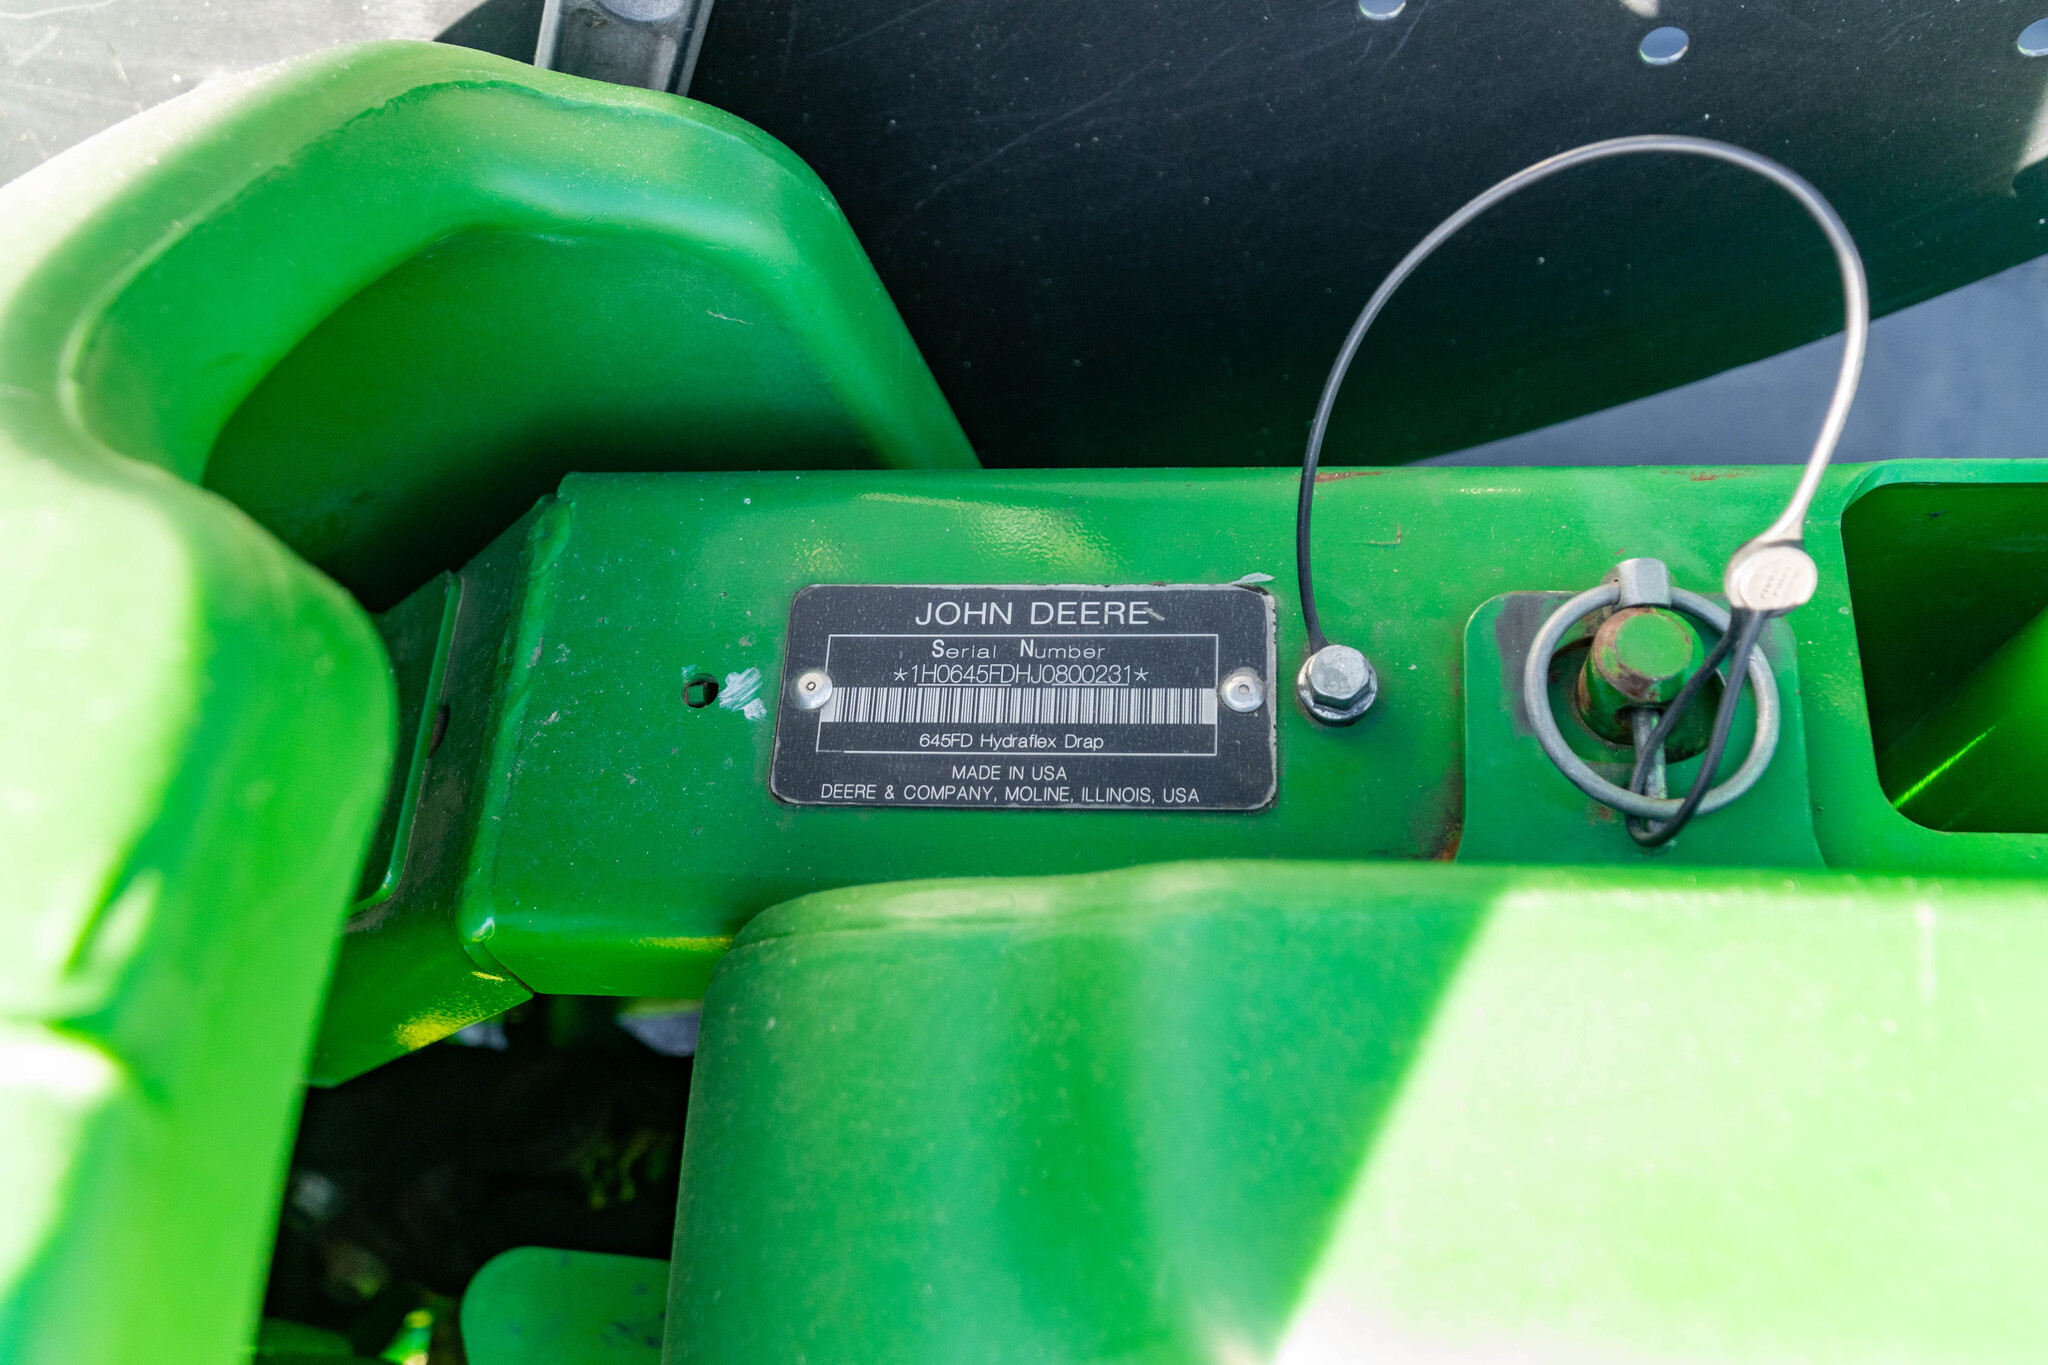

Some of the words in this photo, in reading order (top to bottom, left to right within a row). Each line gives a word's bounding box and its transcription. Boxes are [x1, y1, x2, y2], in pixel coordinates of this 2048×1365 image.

[915, 601, 1013, 626] JOHN
[1030, 601, 1149, 625] DEERE
[931, 639, 997, 659] Serial
[1020, 639, 1106, 659] Number
[919, 733, 973, 748] 645FD
[980, 733, 1057, 751] Hydraflex
[1064, 734, 1104, 751] Drap
[952, 765, 1001, 780] MADE
[1008, 766, 1025, 781] IN
[1031, 766, 1068, 781] USA
[821, 784, 877, 799] DEERE
[884, 784, 895, 800] &
[903, 785, 998, 803] COMPANY,
[1005, 786, 1074, 803] MOLINE,
[1081, 787, 1155, 804] ILLINOIS,
[1163, 787, 1200, 803] USA
